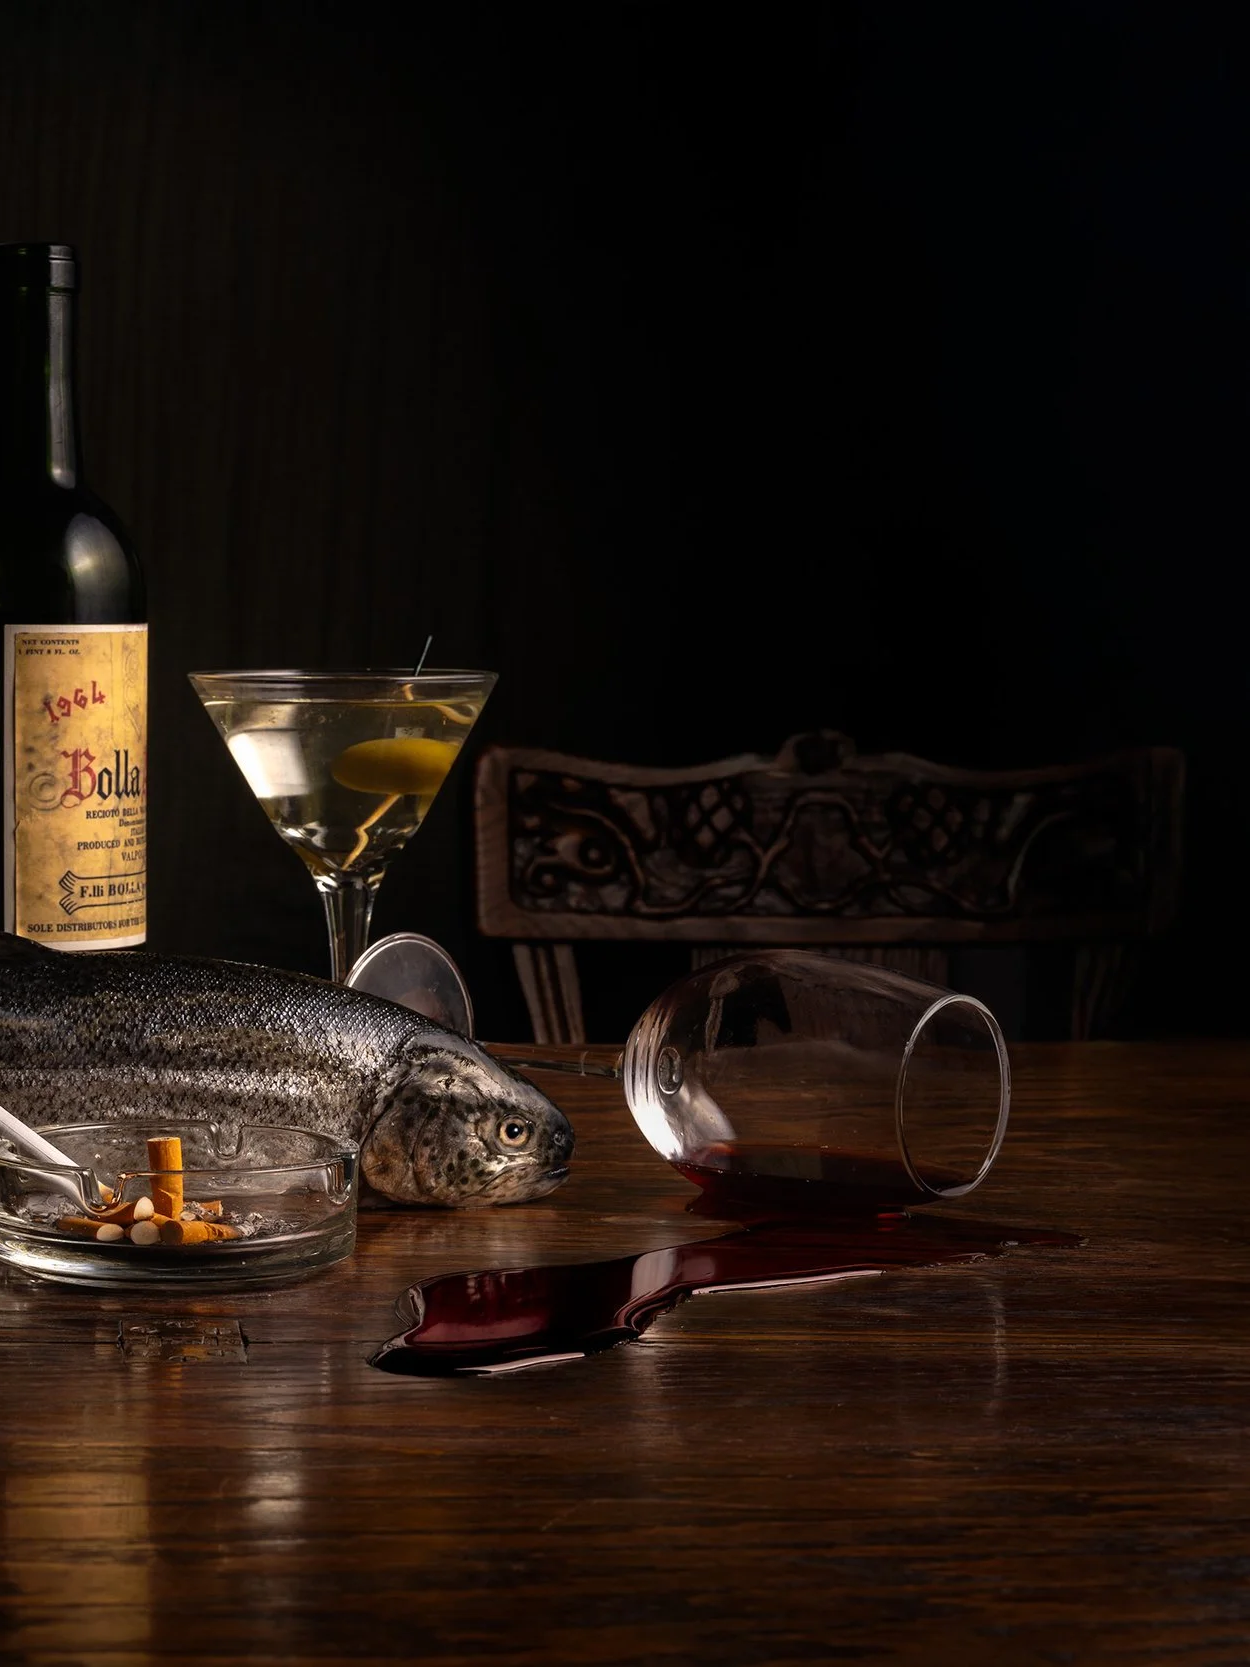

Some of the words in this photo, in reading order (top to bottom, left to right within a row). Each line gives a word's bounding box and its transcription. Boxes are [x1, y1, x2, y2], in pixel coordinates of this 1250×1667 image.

[43, 680, 106, 723] 1964
[60, 748, 140, 808] Bolla
[86, 808, 120, 819] RECIOTO
[77, 840, 120, 850] PRODUCED
[80, 885, 104, 898] F.lli
[108, 881, 141, 897] BOLLA
[27, 923, 54, 933] SOLE
[57, 920, 117, 933] DISTRIBUTORS
